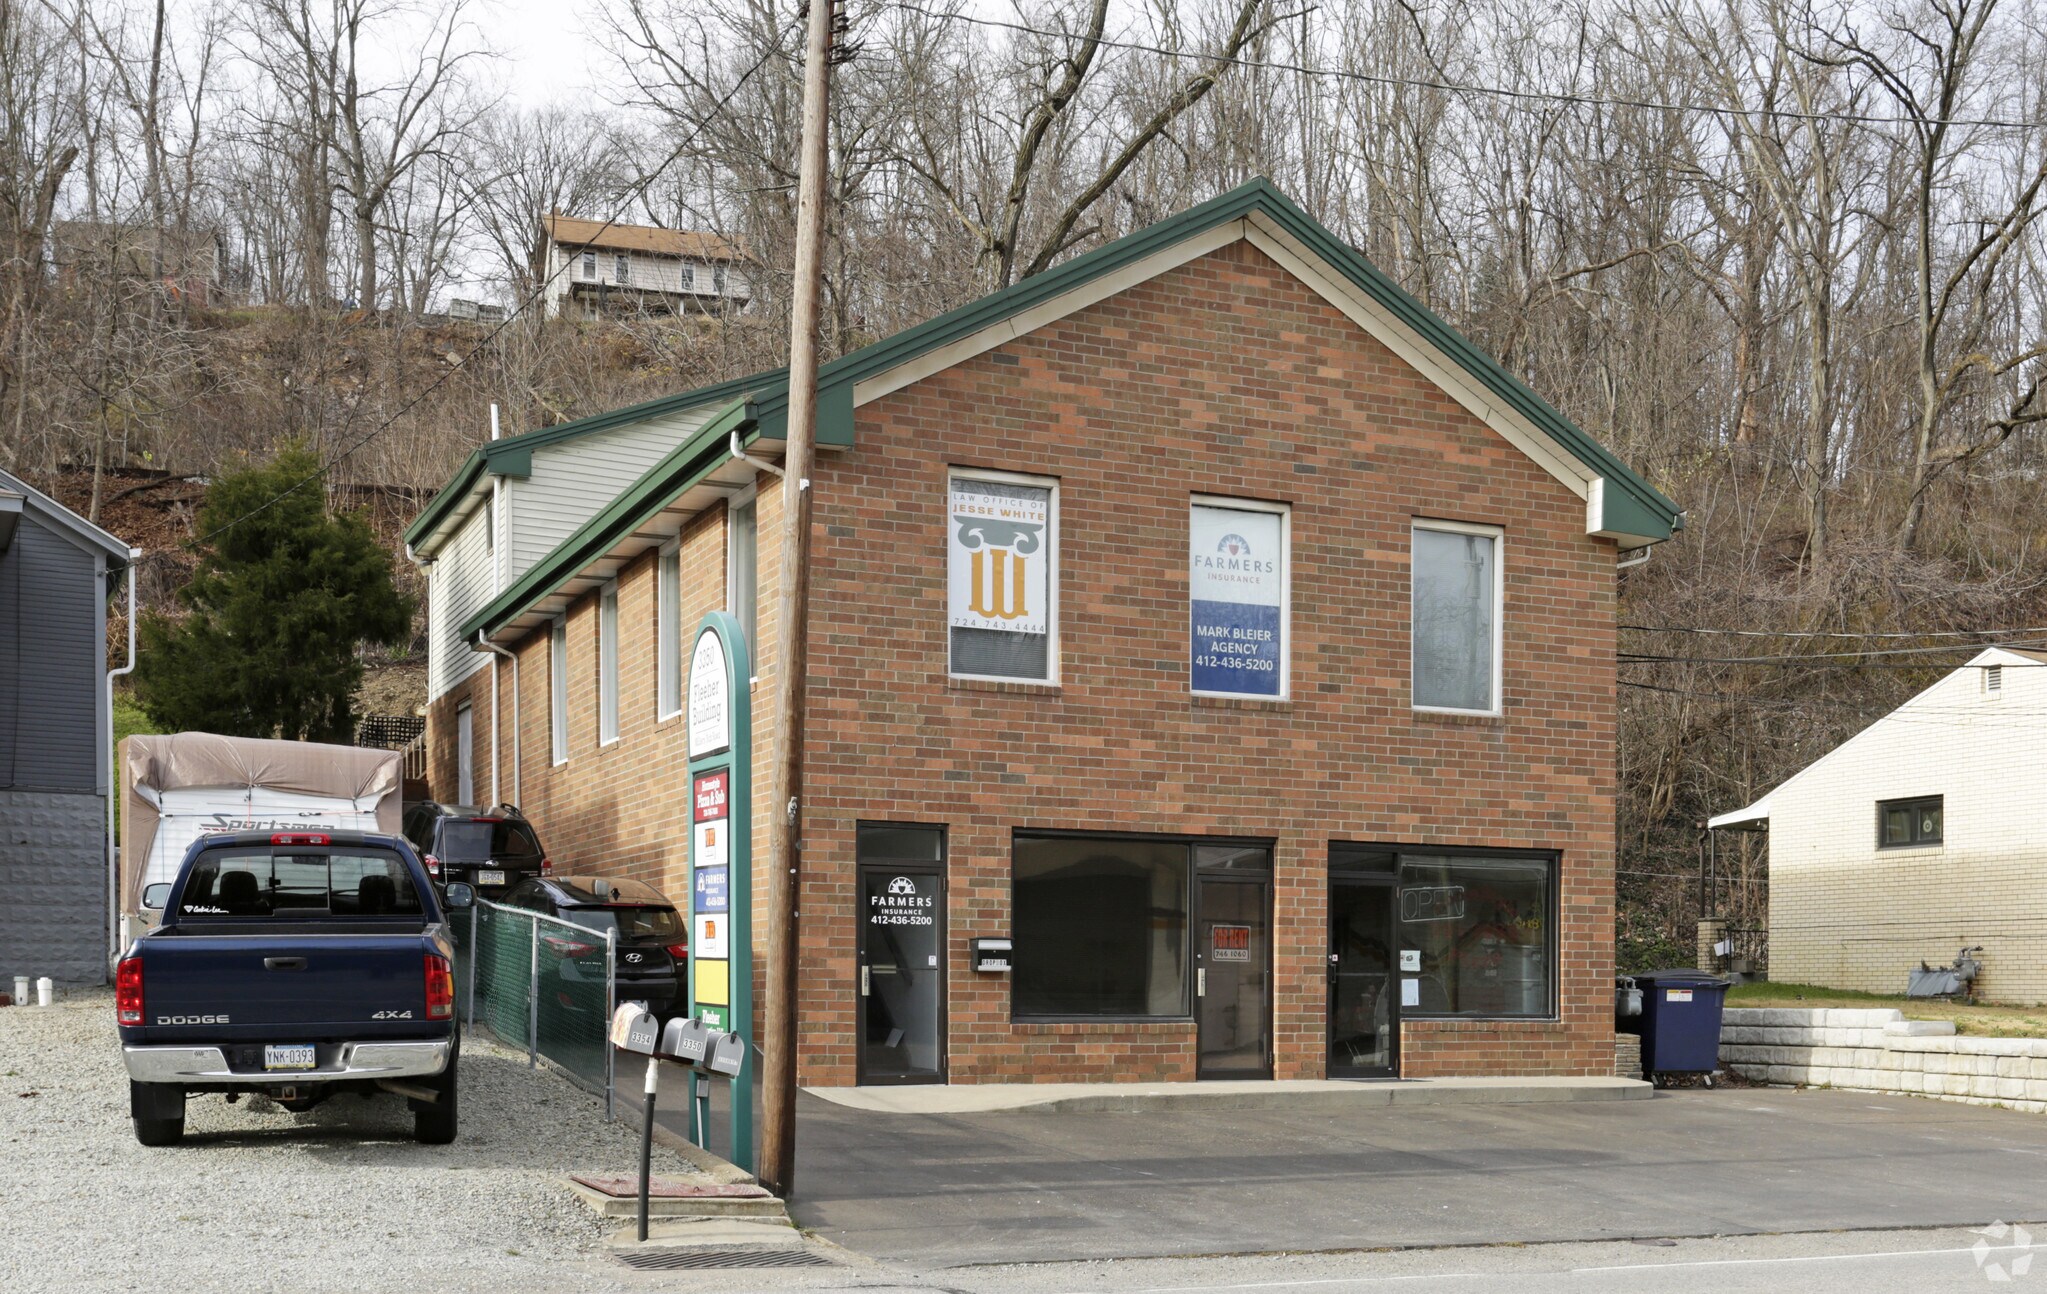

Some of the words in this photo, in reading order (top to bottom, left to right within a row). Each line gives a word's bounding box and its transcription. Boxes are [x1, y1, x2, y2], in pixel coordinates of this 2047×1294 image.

[954, 494, 976, 502] LAW
[983, 496, 1023, 507] OFFICE
[953, 504, 994, 515] JESSE
[1000, 509, 1044, 520] WHITE
[1194, 555, 1273, 573] FARMERS
[1208, 572, 1261, 584] INSURANCE
[954, 618, 1044, 632] 724.743.4444
[1197, 625, 1230, 638] MARK
[1233, 628, 1272, 642] BLEIER
[1211, 641, 1258, 655] AGENCY
[1196, 655, 1274, 671] 412-436-5200
[692, 701, 721, 726] Building
[872, 896, 932, 907] FARMERS
[1404, 890, 1462, 918] OPEN
[871, 916, 932, 925] 412-436-5200
[1214, 928, 1228, 947] FOR
[1230, 929, 1248, 948] RENT
[157, 1014, 230, 1025] DODGE
[632, 1032, 651, 1044] 3354
[683, 1040, 702, 1052] 3350
[266, 1050, 314, 1063] YNK-0393
